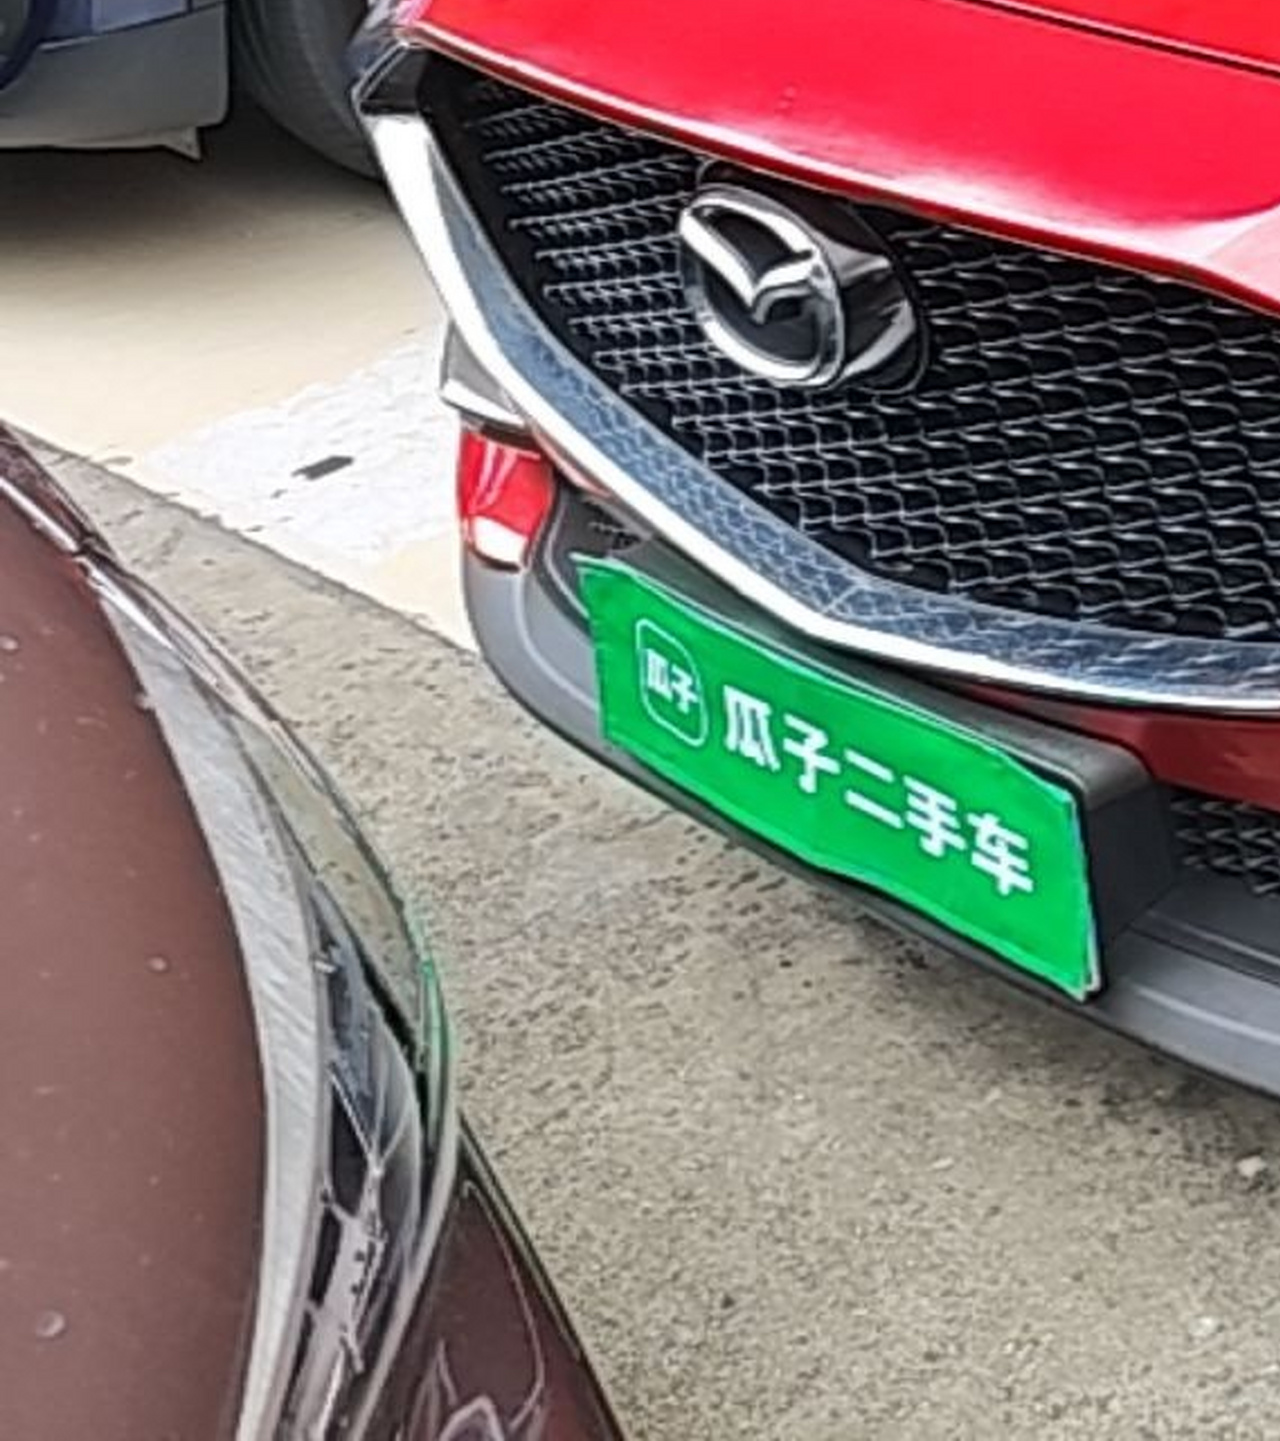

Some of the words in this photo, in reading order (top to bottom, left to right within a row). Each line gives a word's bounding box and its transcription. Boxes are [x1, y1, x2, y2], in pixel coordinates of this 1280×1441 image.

[646, 650, 699, 711] 瓜子
[723, 685, 1034, 896] 瓜子二手车
